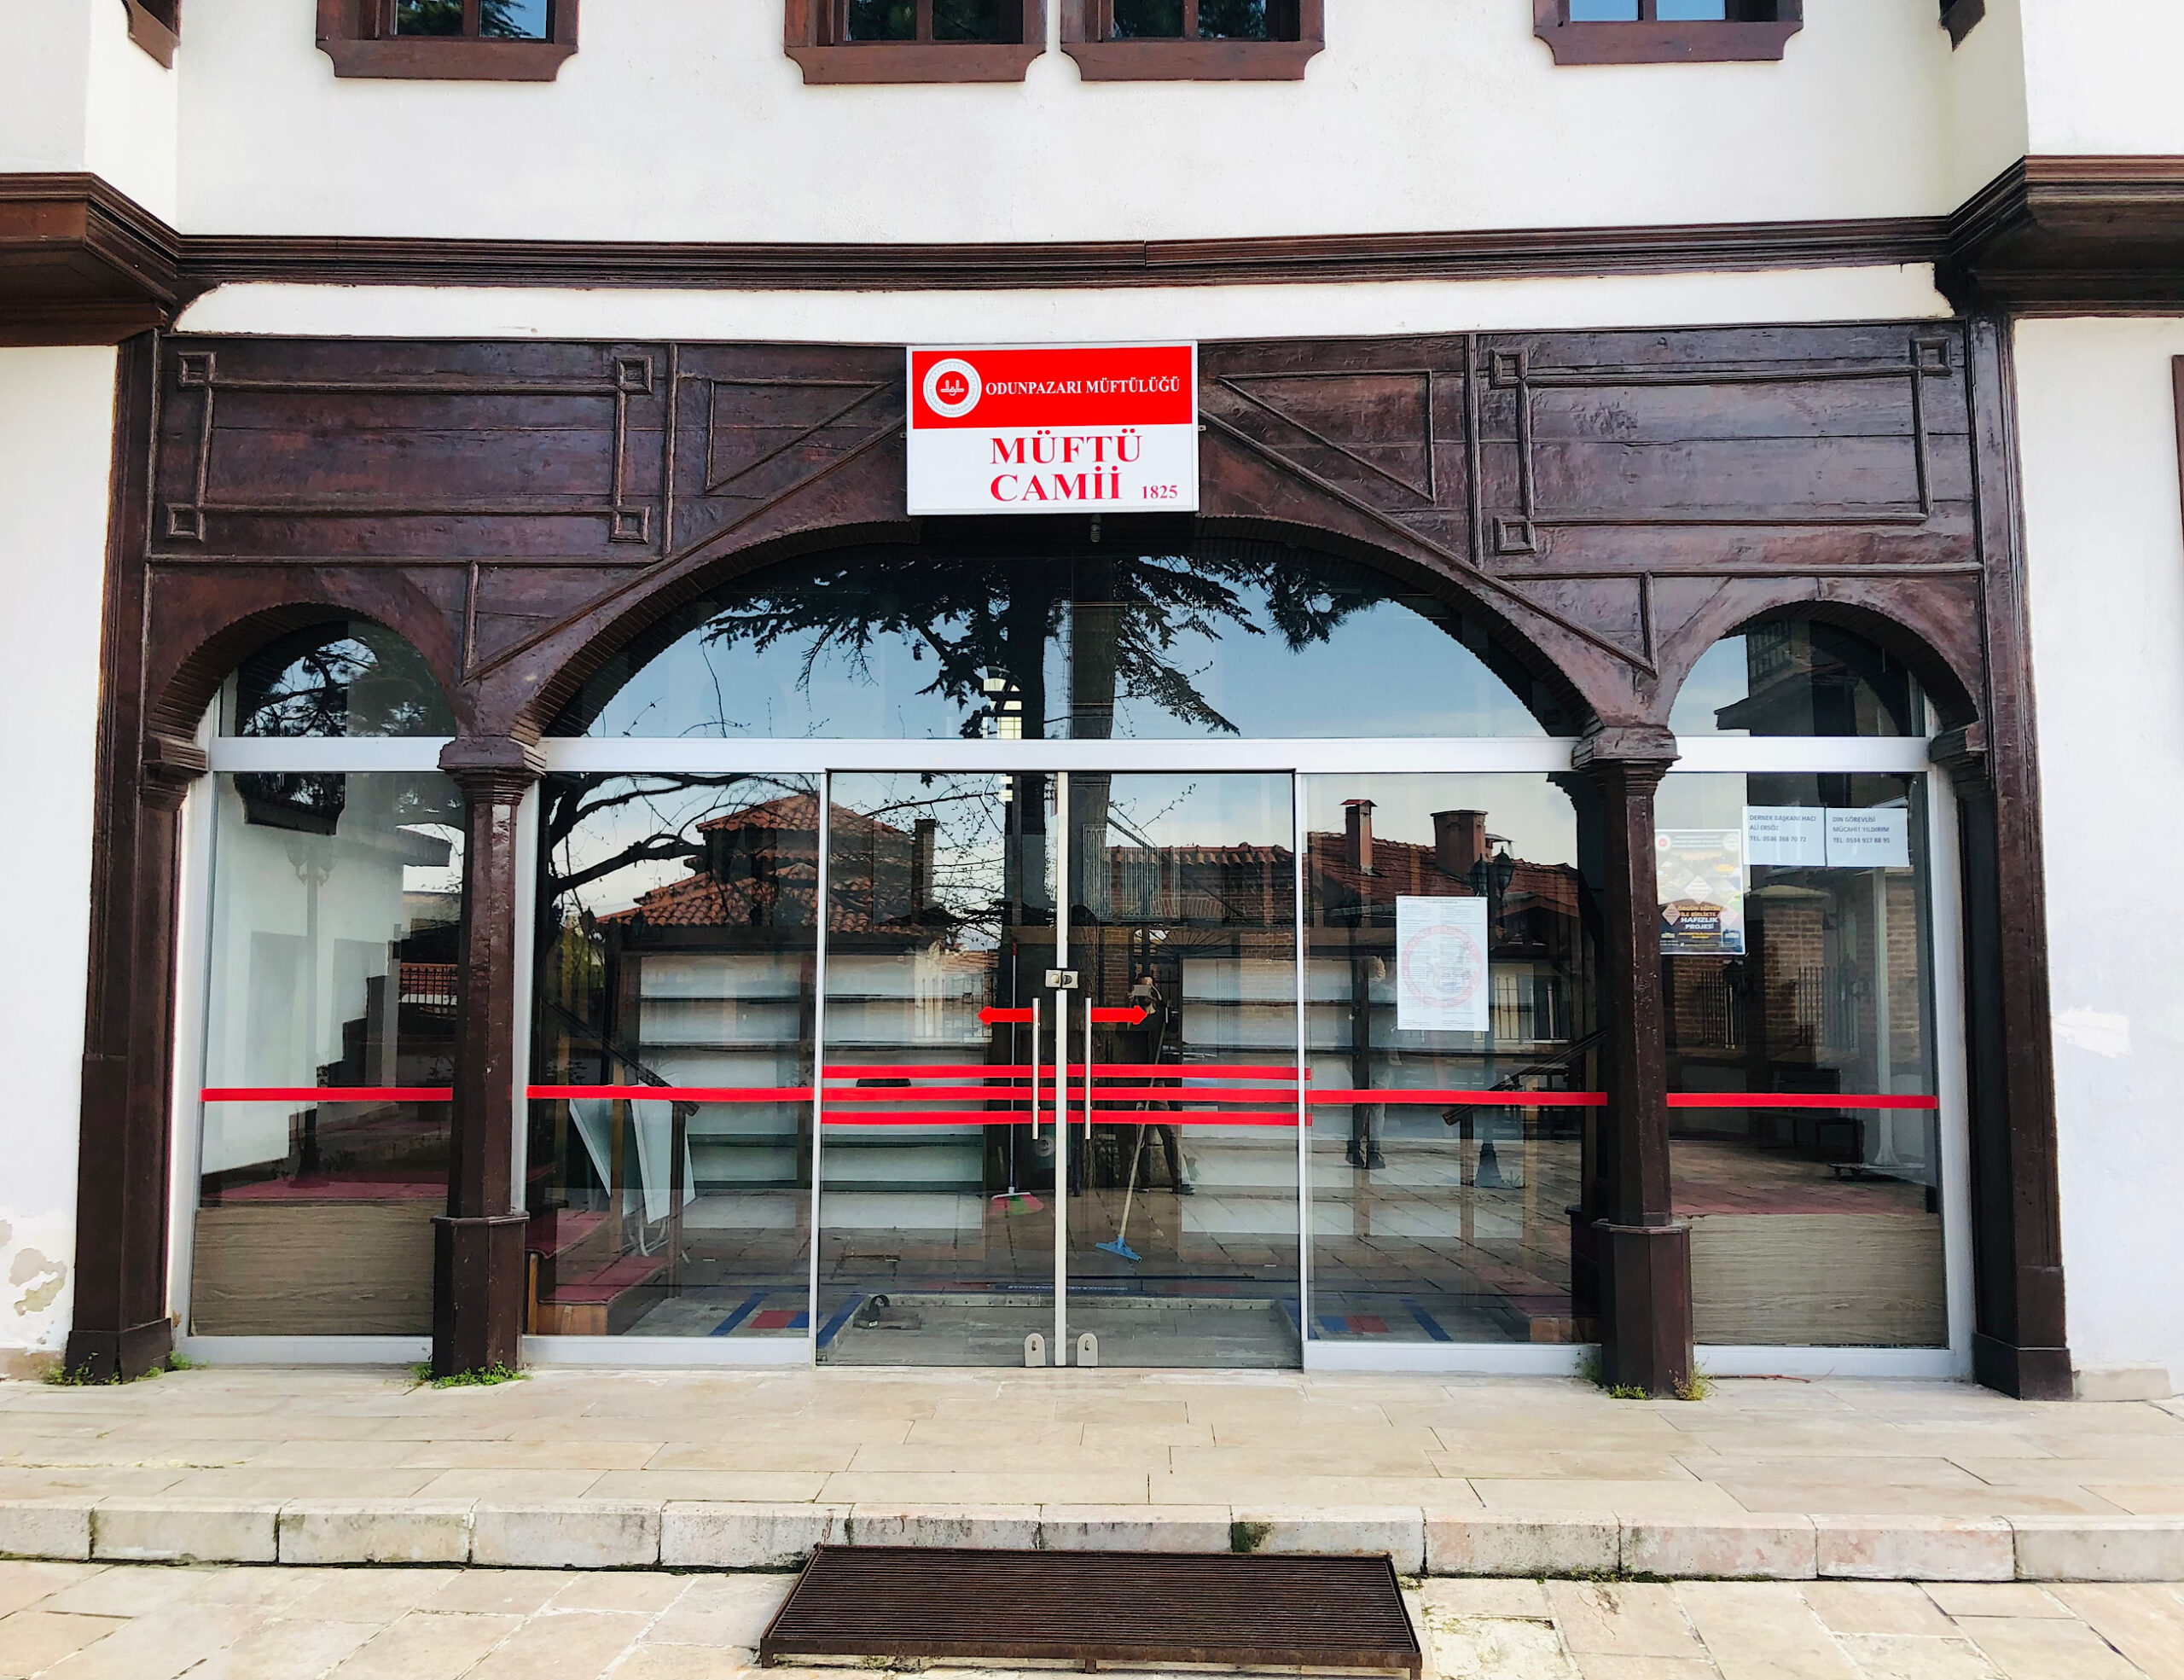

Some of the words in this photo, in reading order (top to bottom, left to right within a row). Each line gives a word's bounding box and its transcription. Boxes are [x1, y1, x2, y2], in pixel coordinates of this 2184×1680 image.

[985, 381, 1082, 395] ODUNPAZARI
[1085, 375, 1181, 393] MÜFTÜLÜĞÜ
[990, 428, 1143, 464] MÜFTÜ
[990, 465, 1123, 502] CAMİİ
[1141, 485, 1178, 499] 1825
